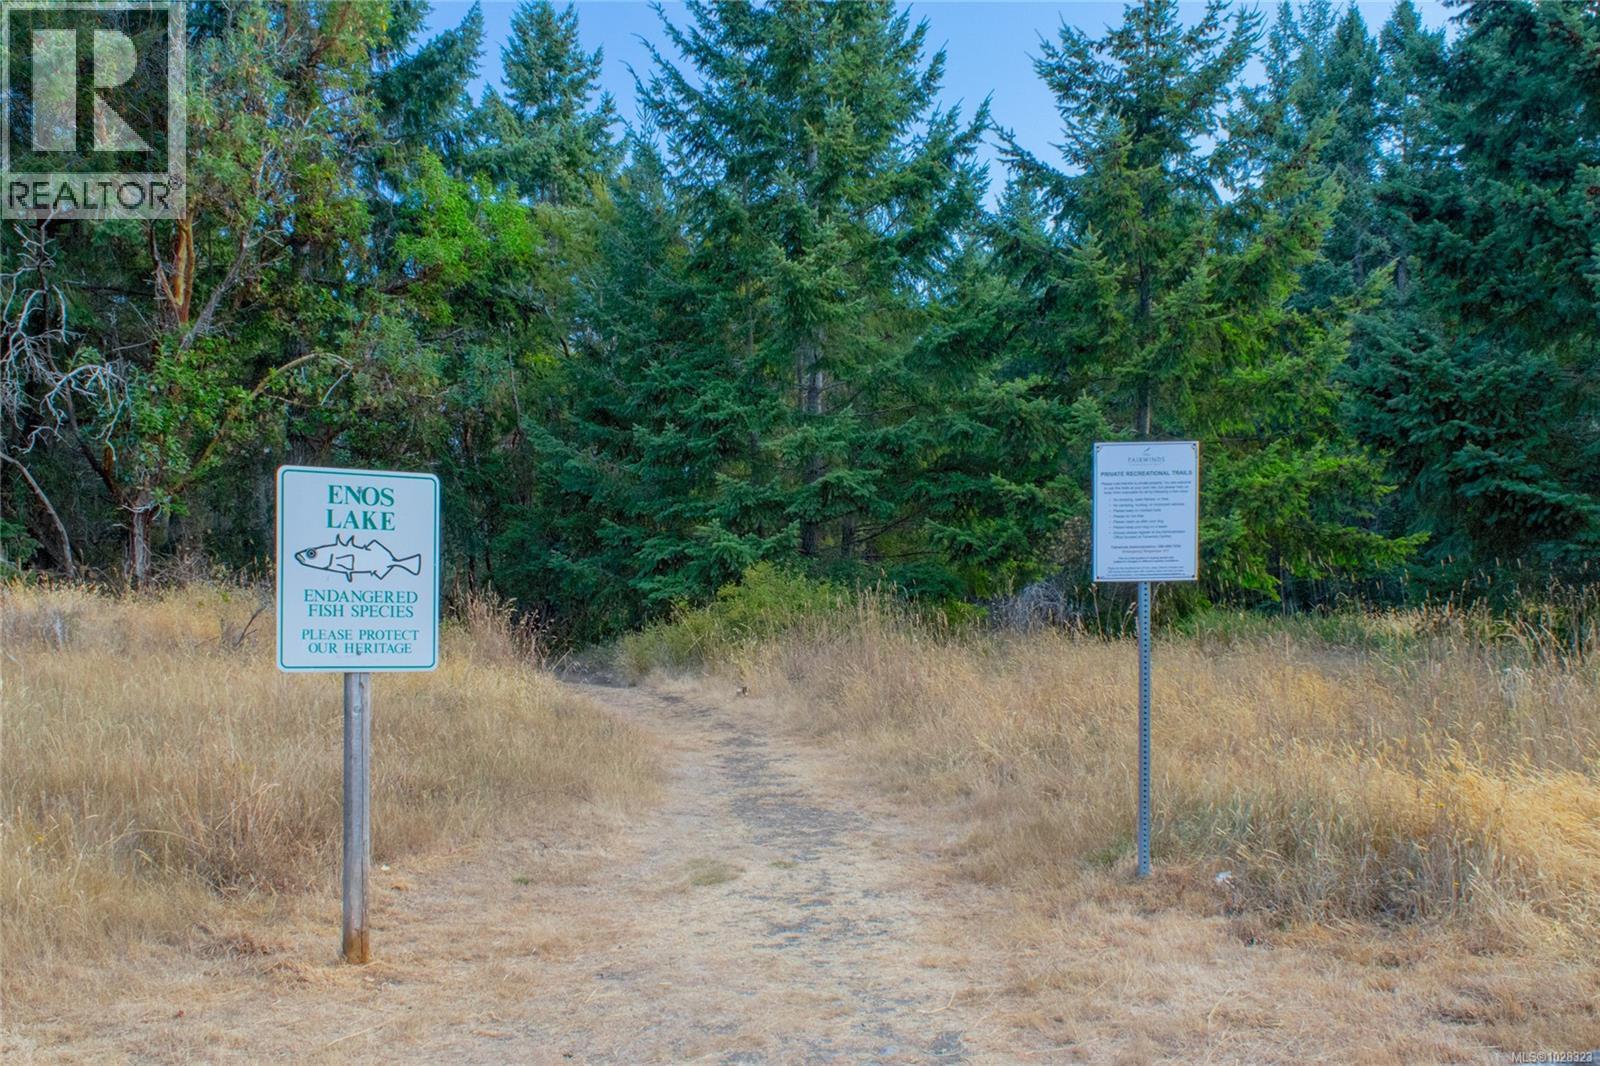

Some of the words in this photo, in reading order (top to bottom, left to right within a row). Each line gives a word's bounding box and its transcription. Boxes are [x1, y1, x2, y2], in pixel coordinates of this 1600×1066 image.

[327, 484, 395, 507] ENOS
[326, 509, 395, 531] LAKE
[303, 589, 419, 604] ENDANGERED
[308, 604, 344, 617] FISH
[351, 605, 414, 618] SPECIES
[302, 629, 352, 641] PLEASE
[359, 629, 420, 641] PROTECT
[308, 643, 338, 654] OUR
[344, 643, 413, 654] HERITAGE
